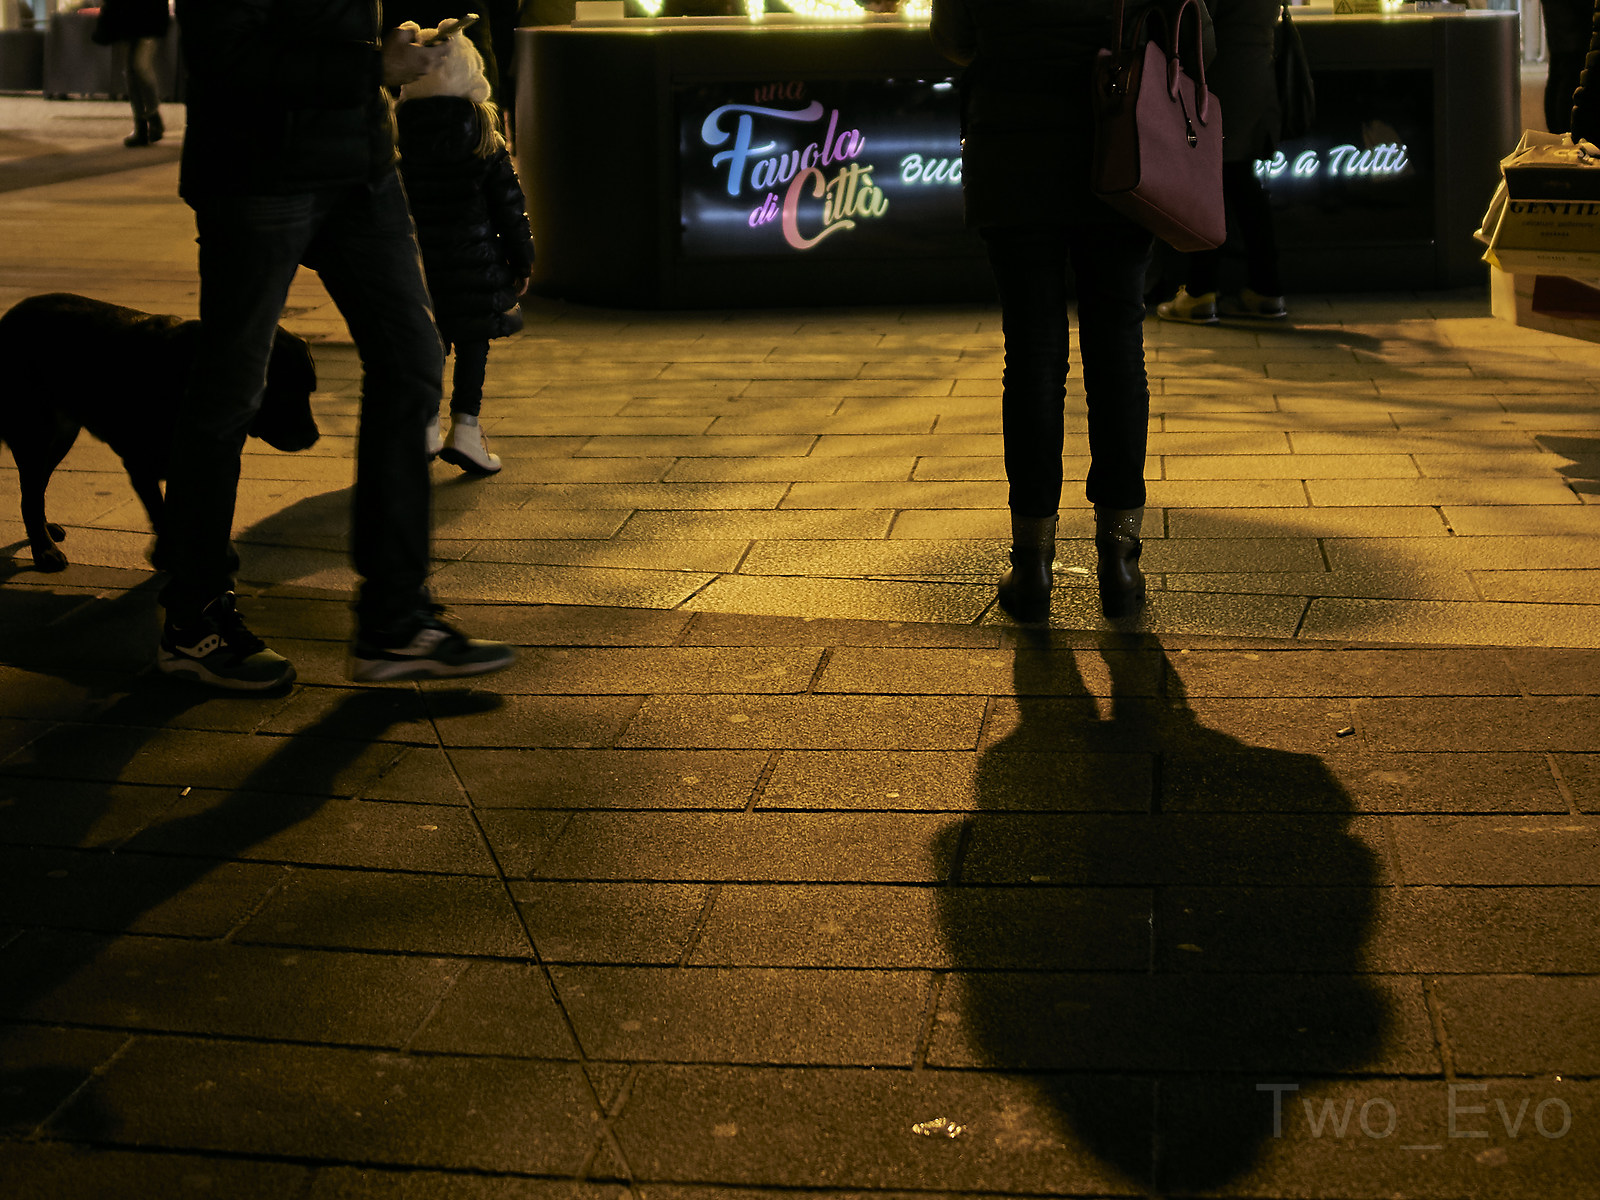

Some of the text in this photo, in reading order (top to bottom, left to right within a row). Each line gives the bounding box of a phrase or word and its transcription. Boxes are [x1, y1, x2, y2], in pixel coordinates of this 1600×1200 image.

[754, 81, 806, 102] una
[702, 100, 865, 195] Favola
[1294, 151, 1319, 176] a
[1329, 143, 1408, 176] Tutti
[749, 163, 888, 249] di Città
